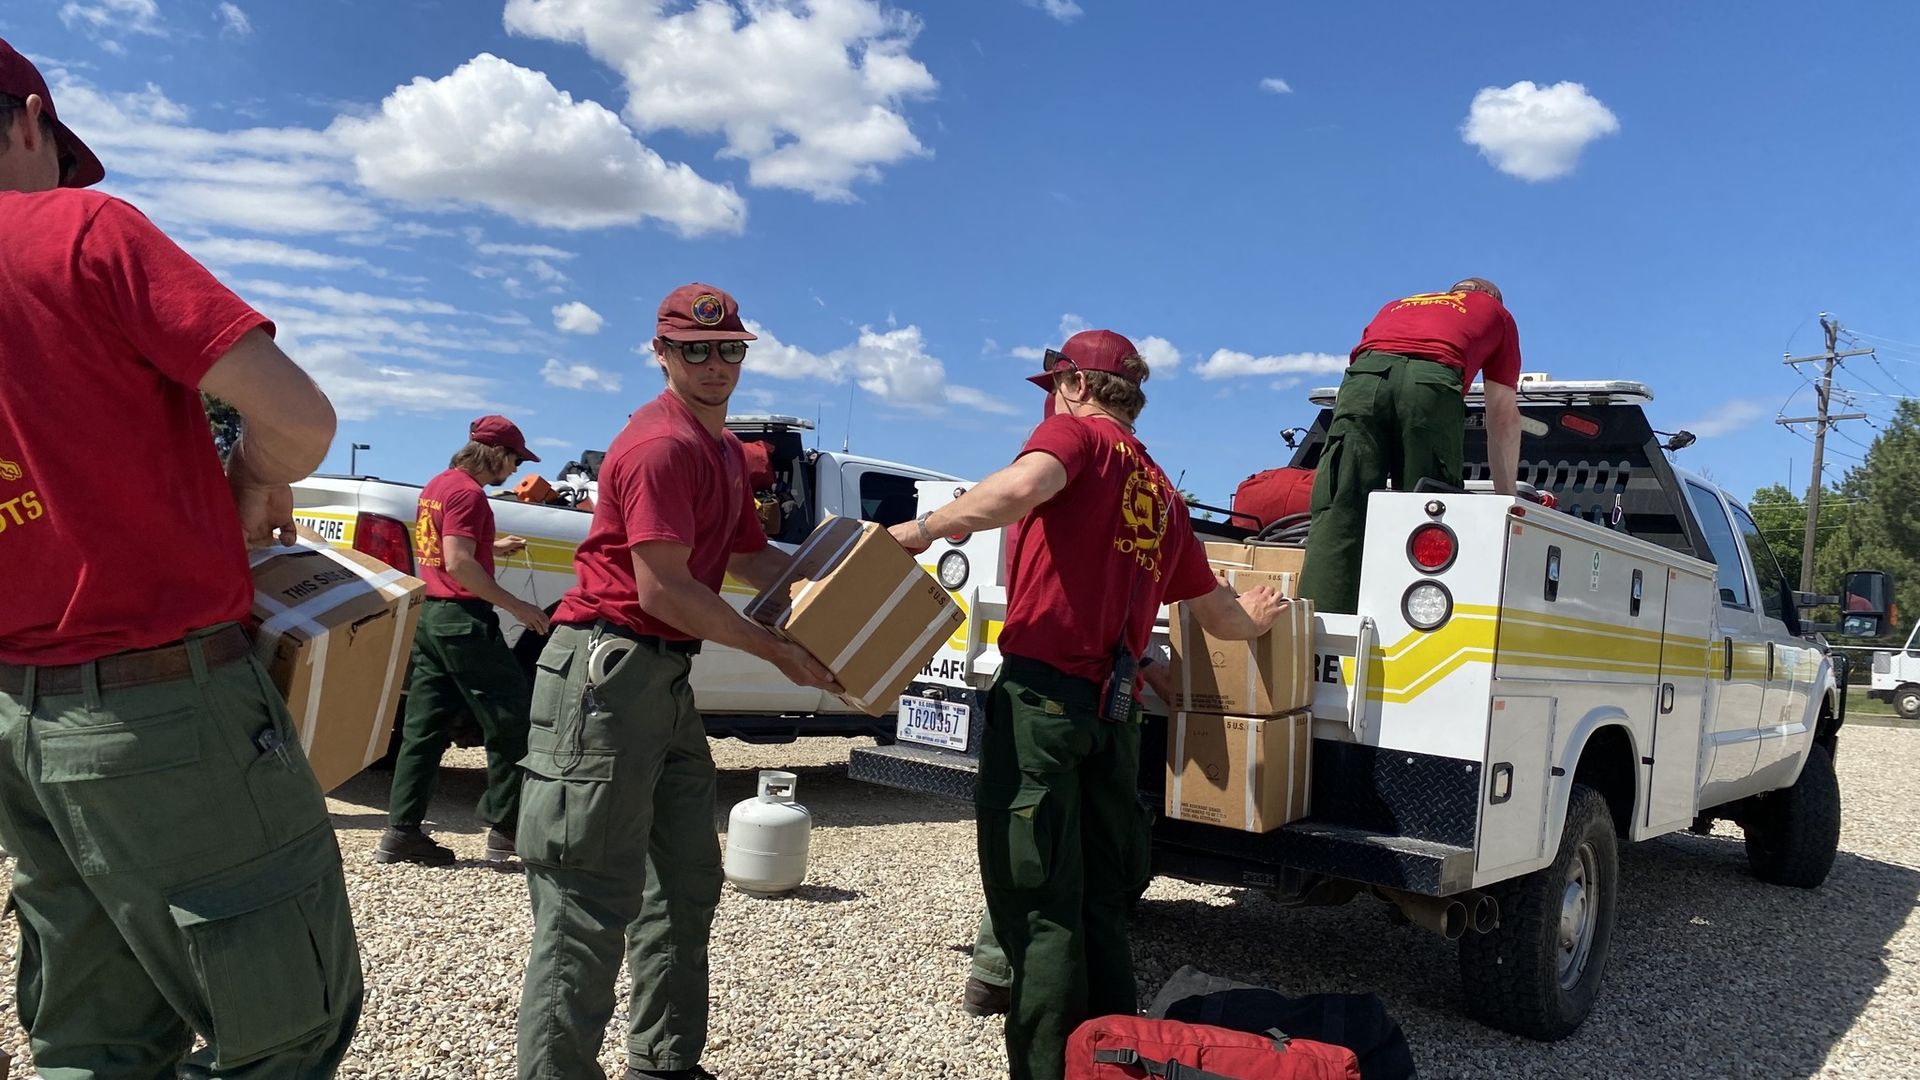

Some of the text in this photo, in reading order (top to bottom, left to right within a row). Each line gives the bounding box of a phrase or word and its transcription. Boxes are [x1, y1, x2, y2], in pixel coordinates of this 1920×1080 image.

[318, 519, 344, 540] FIRE
[281, 580, 319, 600] THIS
[928, 586, 936, 594] 5
[919, 656, 966, 682] K-AFS
[1226, 721, 1232, 729] 5
[1232, 723, 1246, 731] U.S.
